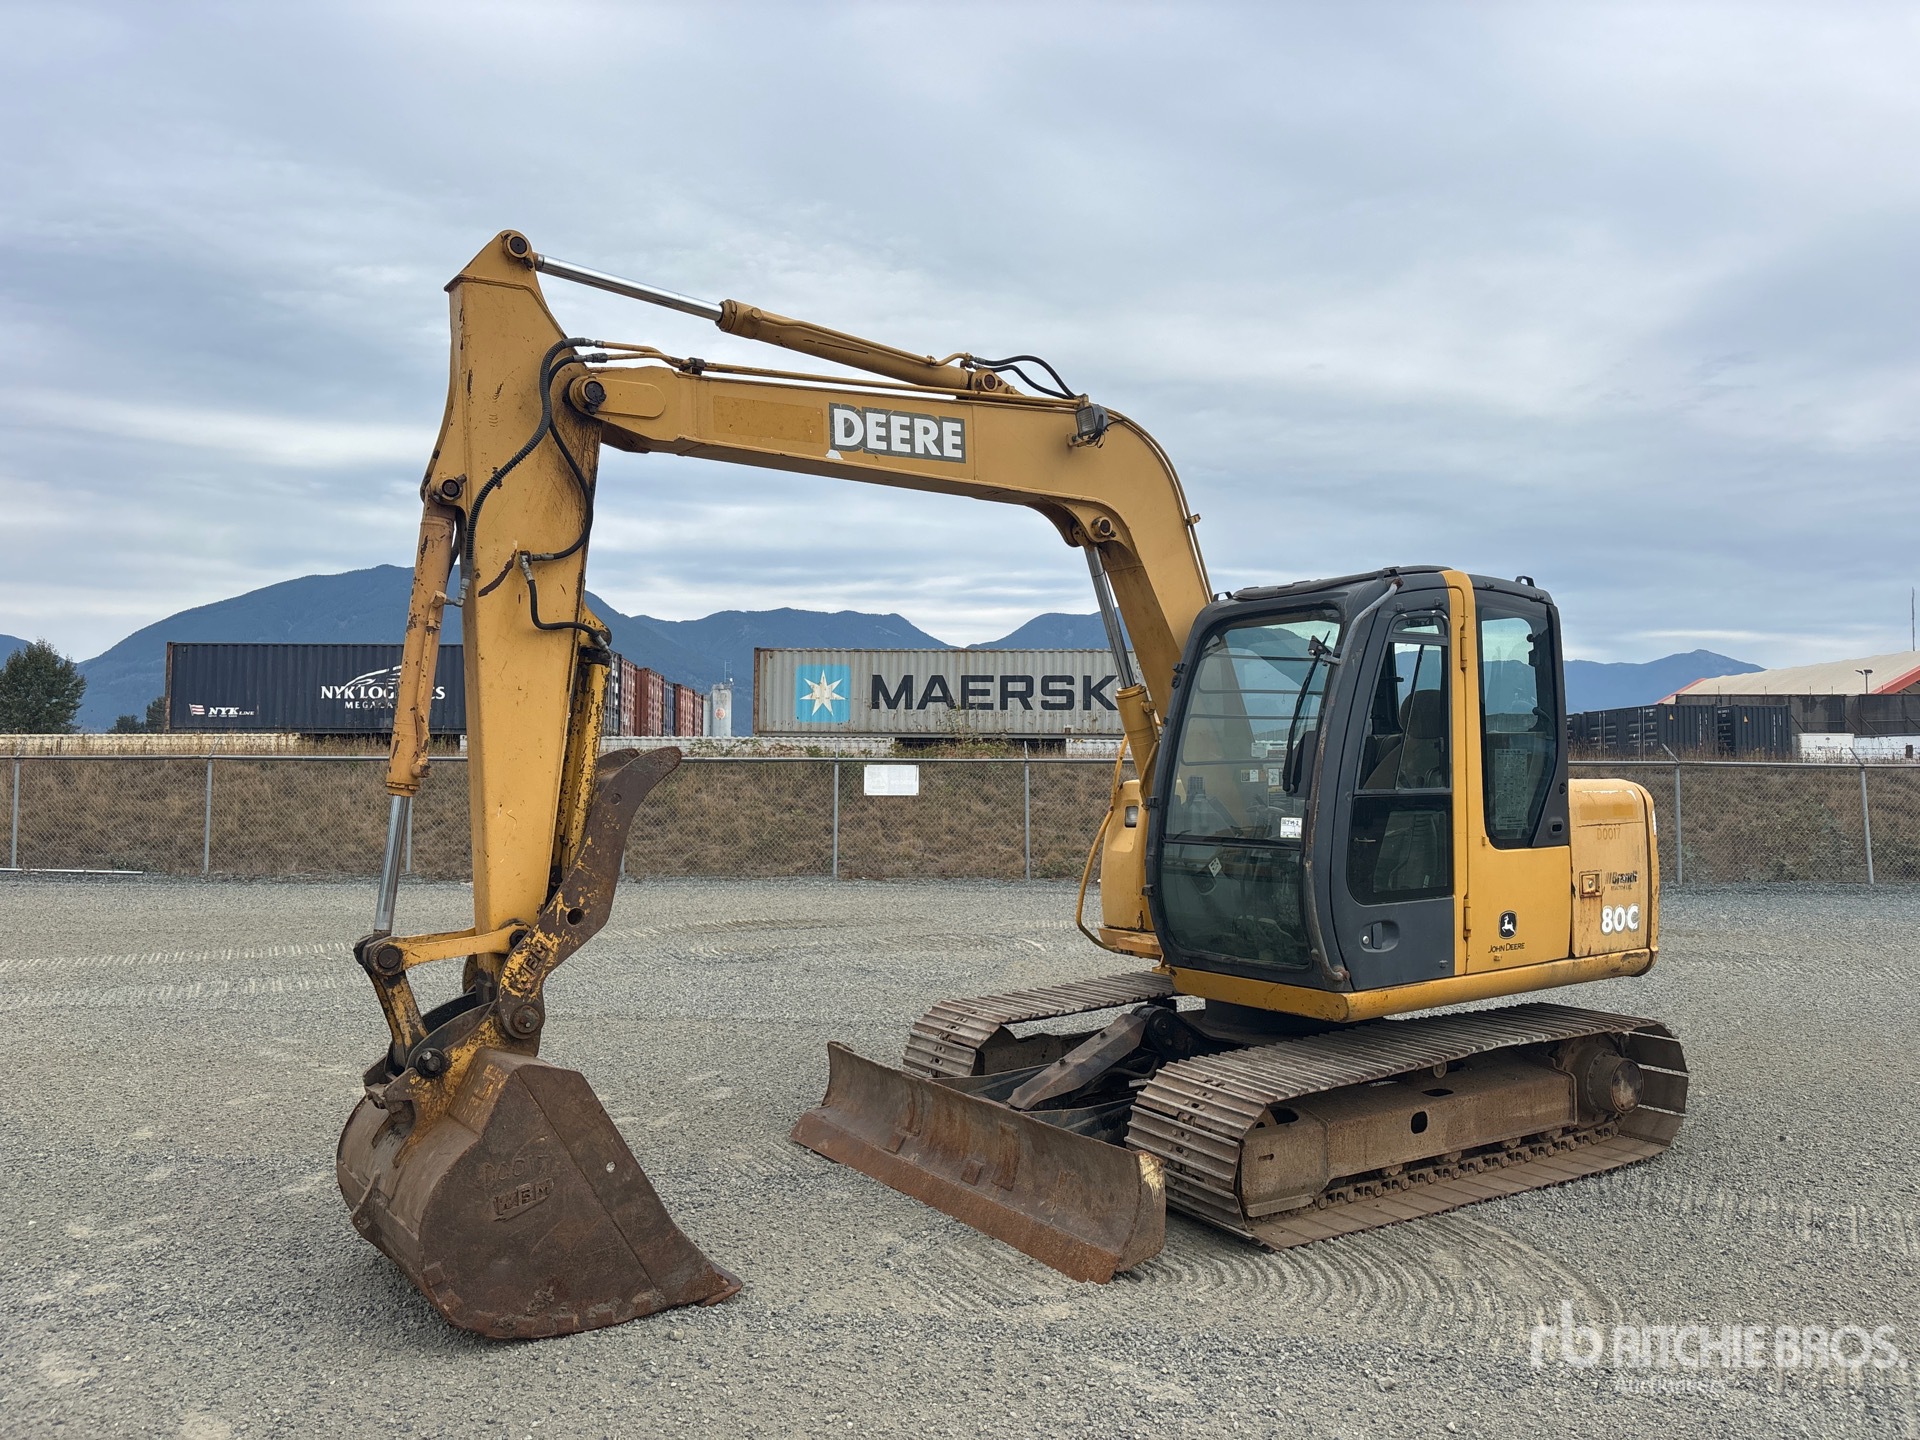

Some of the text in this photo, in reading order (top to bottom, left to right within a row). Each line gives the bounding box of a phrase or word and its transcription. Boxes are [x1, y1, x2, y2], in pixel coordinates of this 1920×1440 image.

[833, 408, 962, 458] DEERE
[321, 685, 355, 699] NYK
[871, 674, 1118, 711] MAERSK
[208, 706, 239, 715] NYK
[1602, 904, 1639, 933] 80C
[1488, 942, 1525, 954] JOHN DEERE
